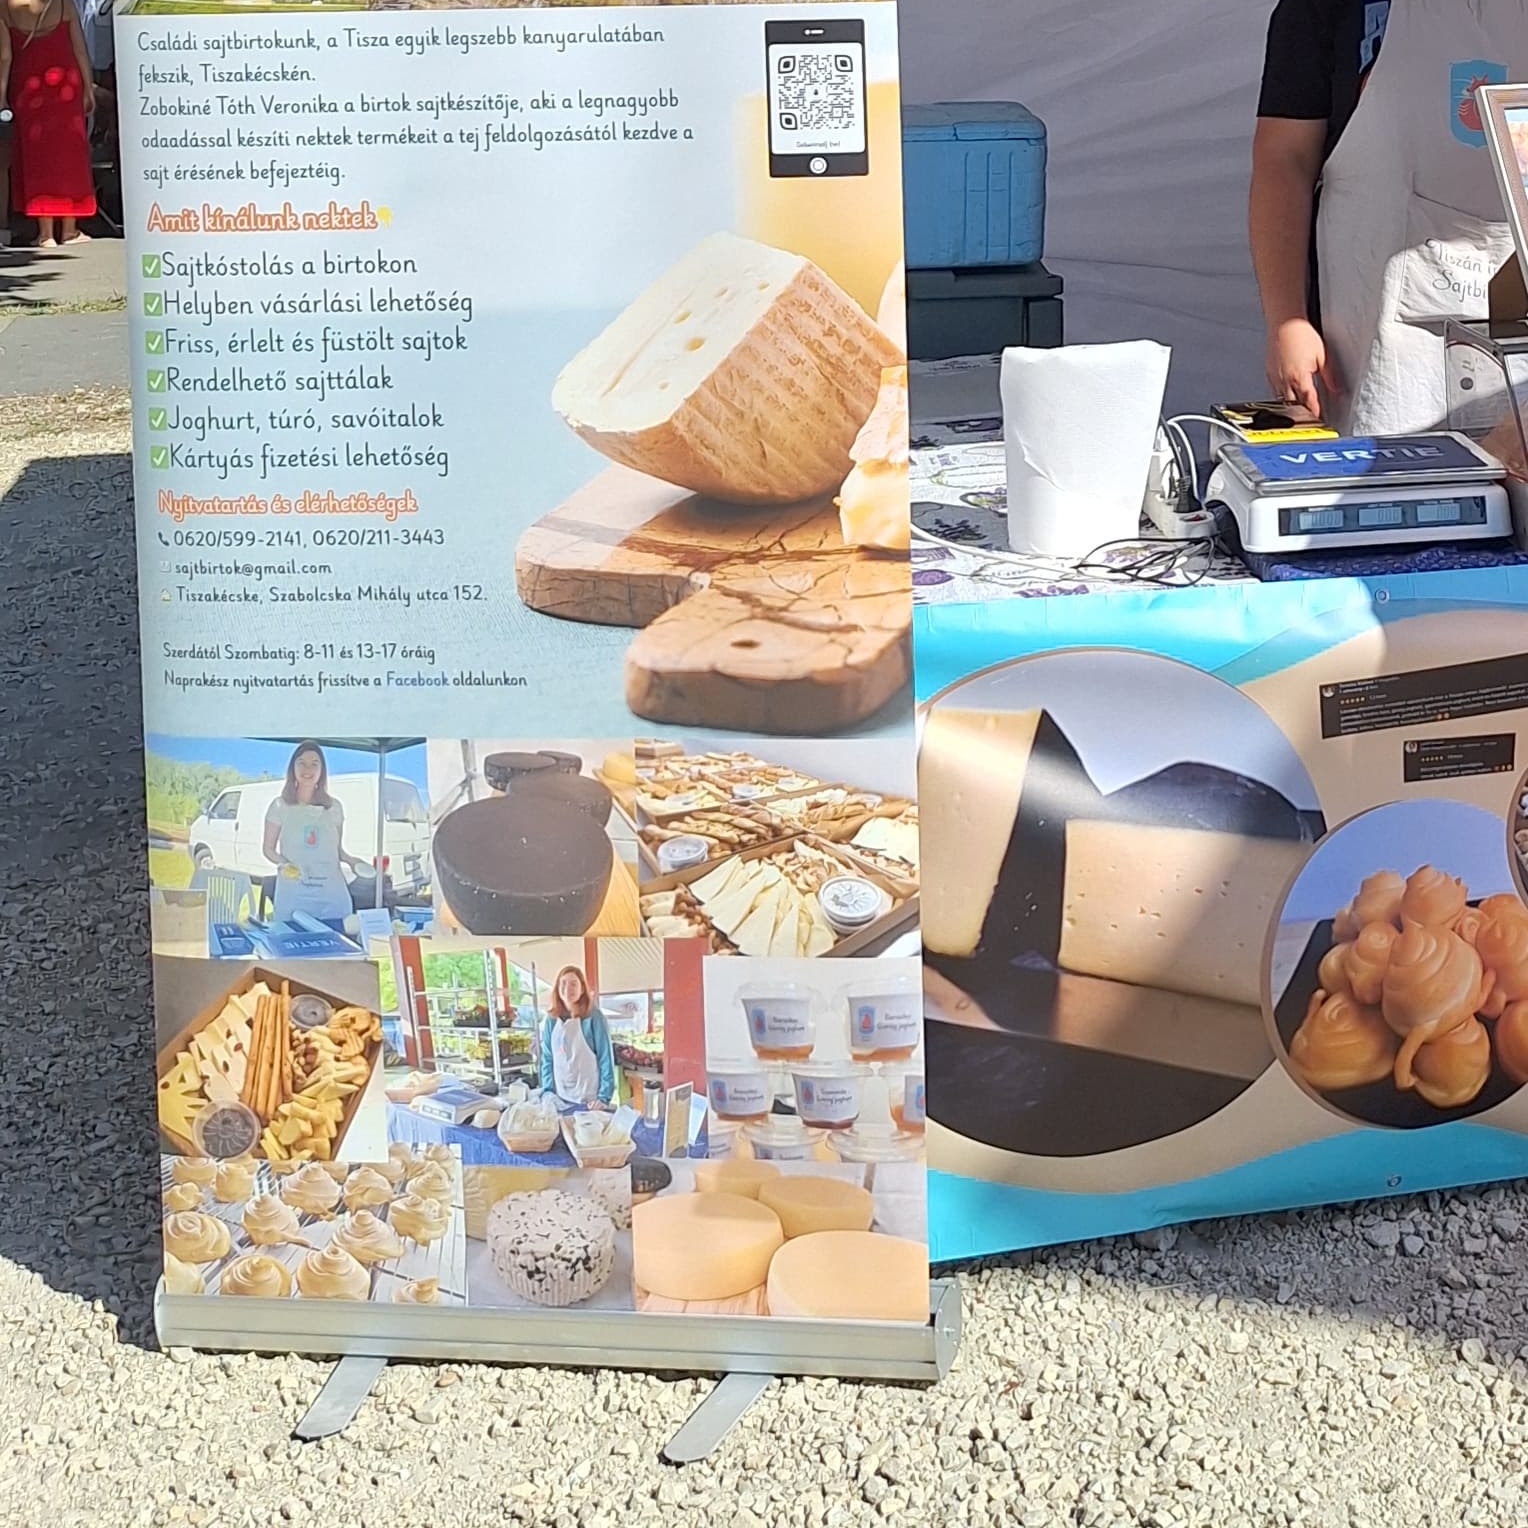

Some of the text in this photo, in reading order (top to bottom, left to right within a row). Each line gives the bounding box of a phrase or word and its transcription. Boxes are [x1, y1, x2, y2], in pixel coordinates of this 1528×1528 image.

[137, 24, 665, 55] Családi sajtbirtokunk, a Tisza egyik legszebb kanyarulatában
[138, 62, 315, 91] fekszik, Tiszakécskén.
[140, 88, 679, 119] Zobokiné Tóth Veronika a birtok sajtkészítője, aki a legnagyobb
[141, 121, 694, 151] odaadással készíti nektek termékeit a tej feldolgozásától kezdve a
[143, 160, 346, 189] sajt érésének befejeztéig.
[147, 202, 379, 233] Amit kínálunk nektek
[162, 250, 417, 287] Sajtkóstolás a birtokon
[164, 287, 473, 326] Helyben vásárlási lehetőség
[166, 325, 468, 360] Friss, érlelt és füstölt sajtok
[167, 364, 393, 401] Rendelhető sajttálak
[167, 403, 444, 441] Joghurt, túró, savóitalok
[170, 441, 448, 479] Kártyás fizetési lehetőség
[1280, 446, 1446, 464] VERTIE
[158, 489, 418, 521] Nyitvatartás és elérhetőségek
[174, 528, 445, 549] 0620/599-2141, 0620/211-3443
[175, 558, 332, 579] sajtbirtok@gmail.com
[176, 584, 488, 606] Tiszakécske, Szabolcska Mihály utca 152.
[163, 641, 435, 666] Szerdától Szombatig: 8-11 és 13-17 óráig
[164, 669, 527, 693] Naprakész nyitvatartás frissítve a Facebook oldalunkon
